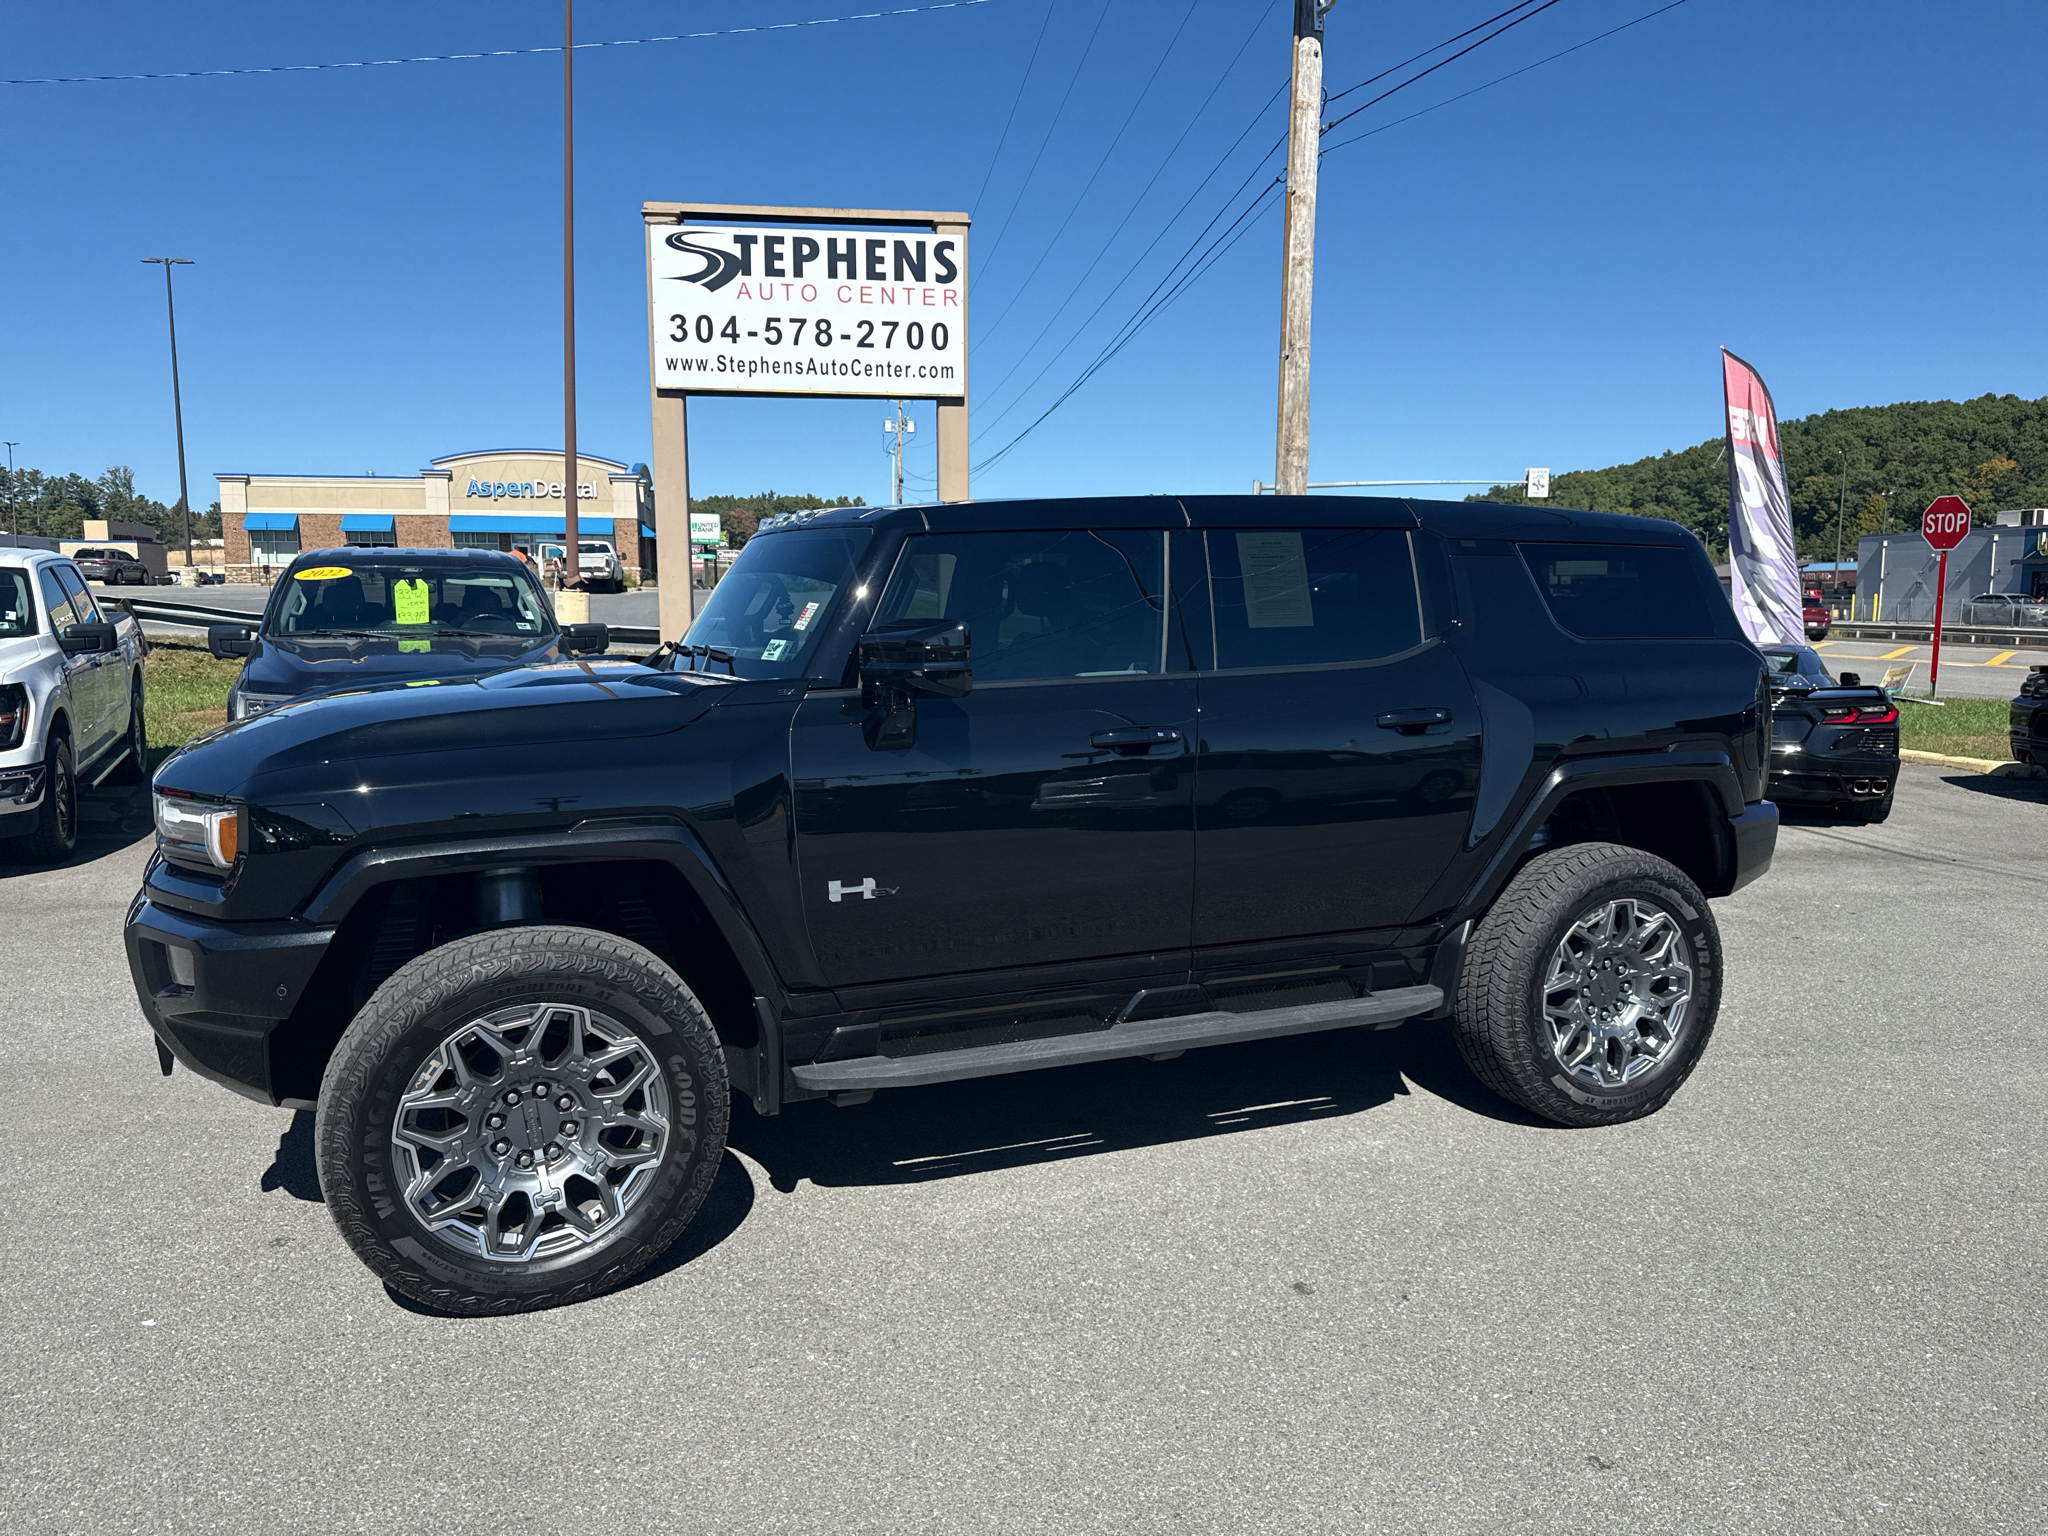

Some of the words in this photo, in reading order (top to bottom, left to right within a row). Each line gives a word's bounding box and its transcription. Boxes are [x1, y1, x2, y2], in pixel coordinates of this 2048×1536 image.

[737, 282, 818, 302] AUTO
[837, 285, 959, 307] CENTER
[669, 313, 949, 351] 304-578-2700
[665, 354, 955, 380] www.StephensAutoCenter.com
[1925, 512, 1967, 534] STOP
[303, 569, 343, 578] 2022
